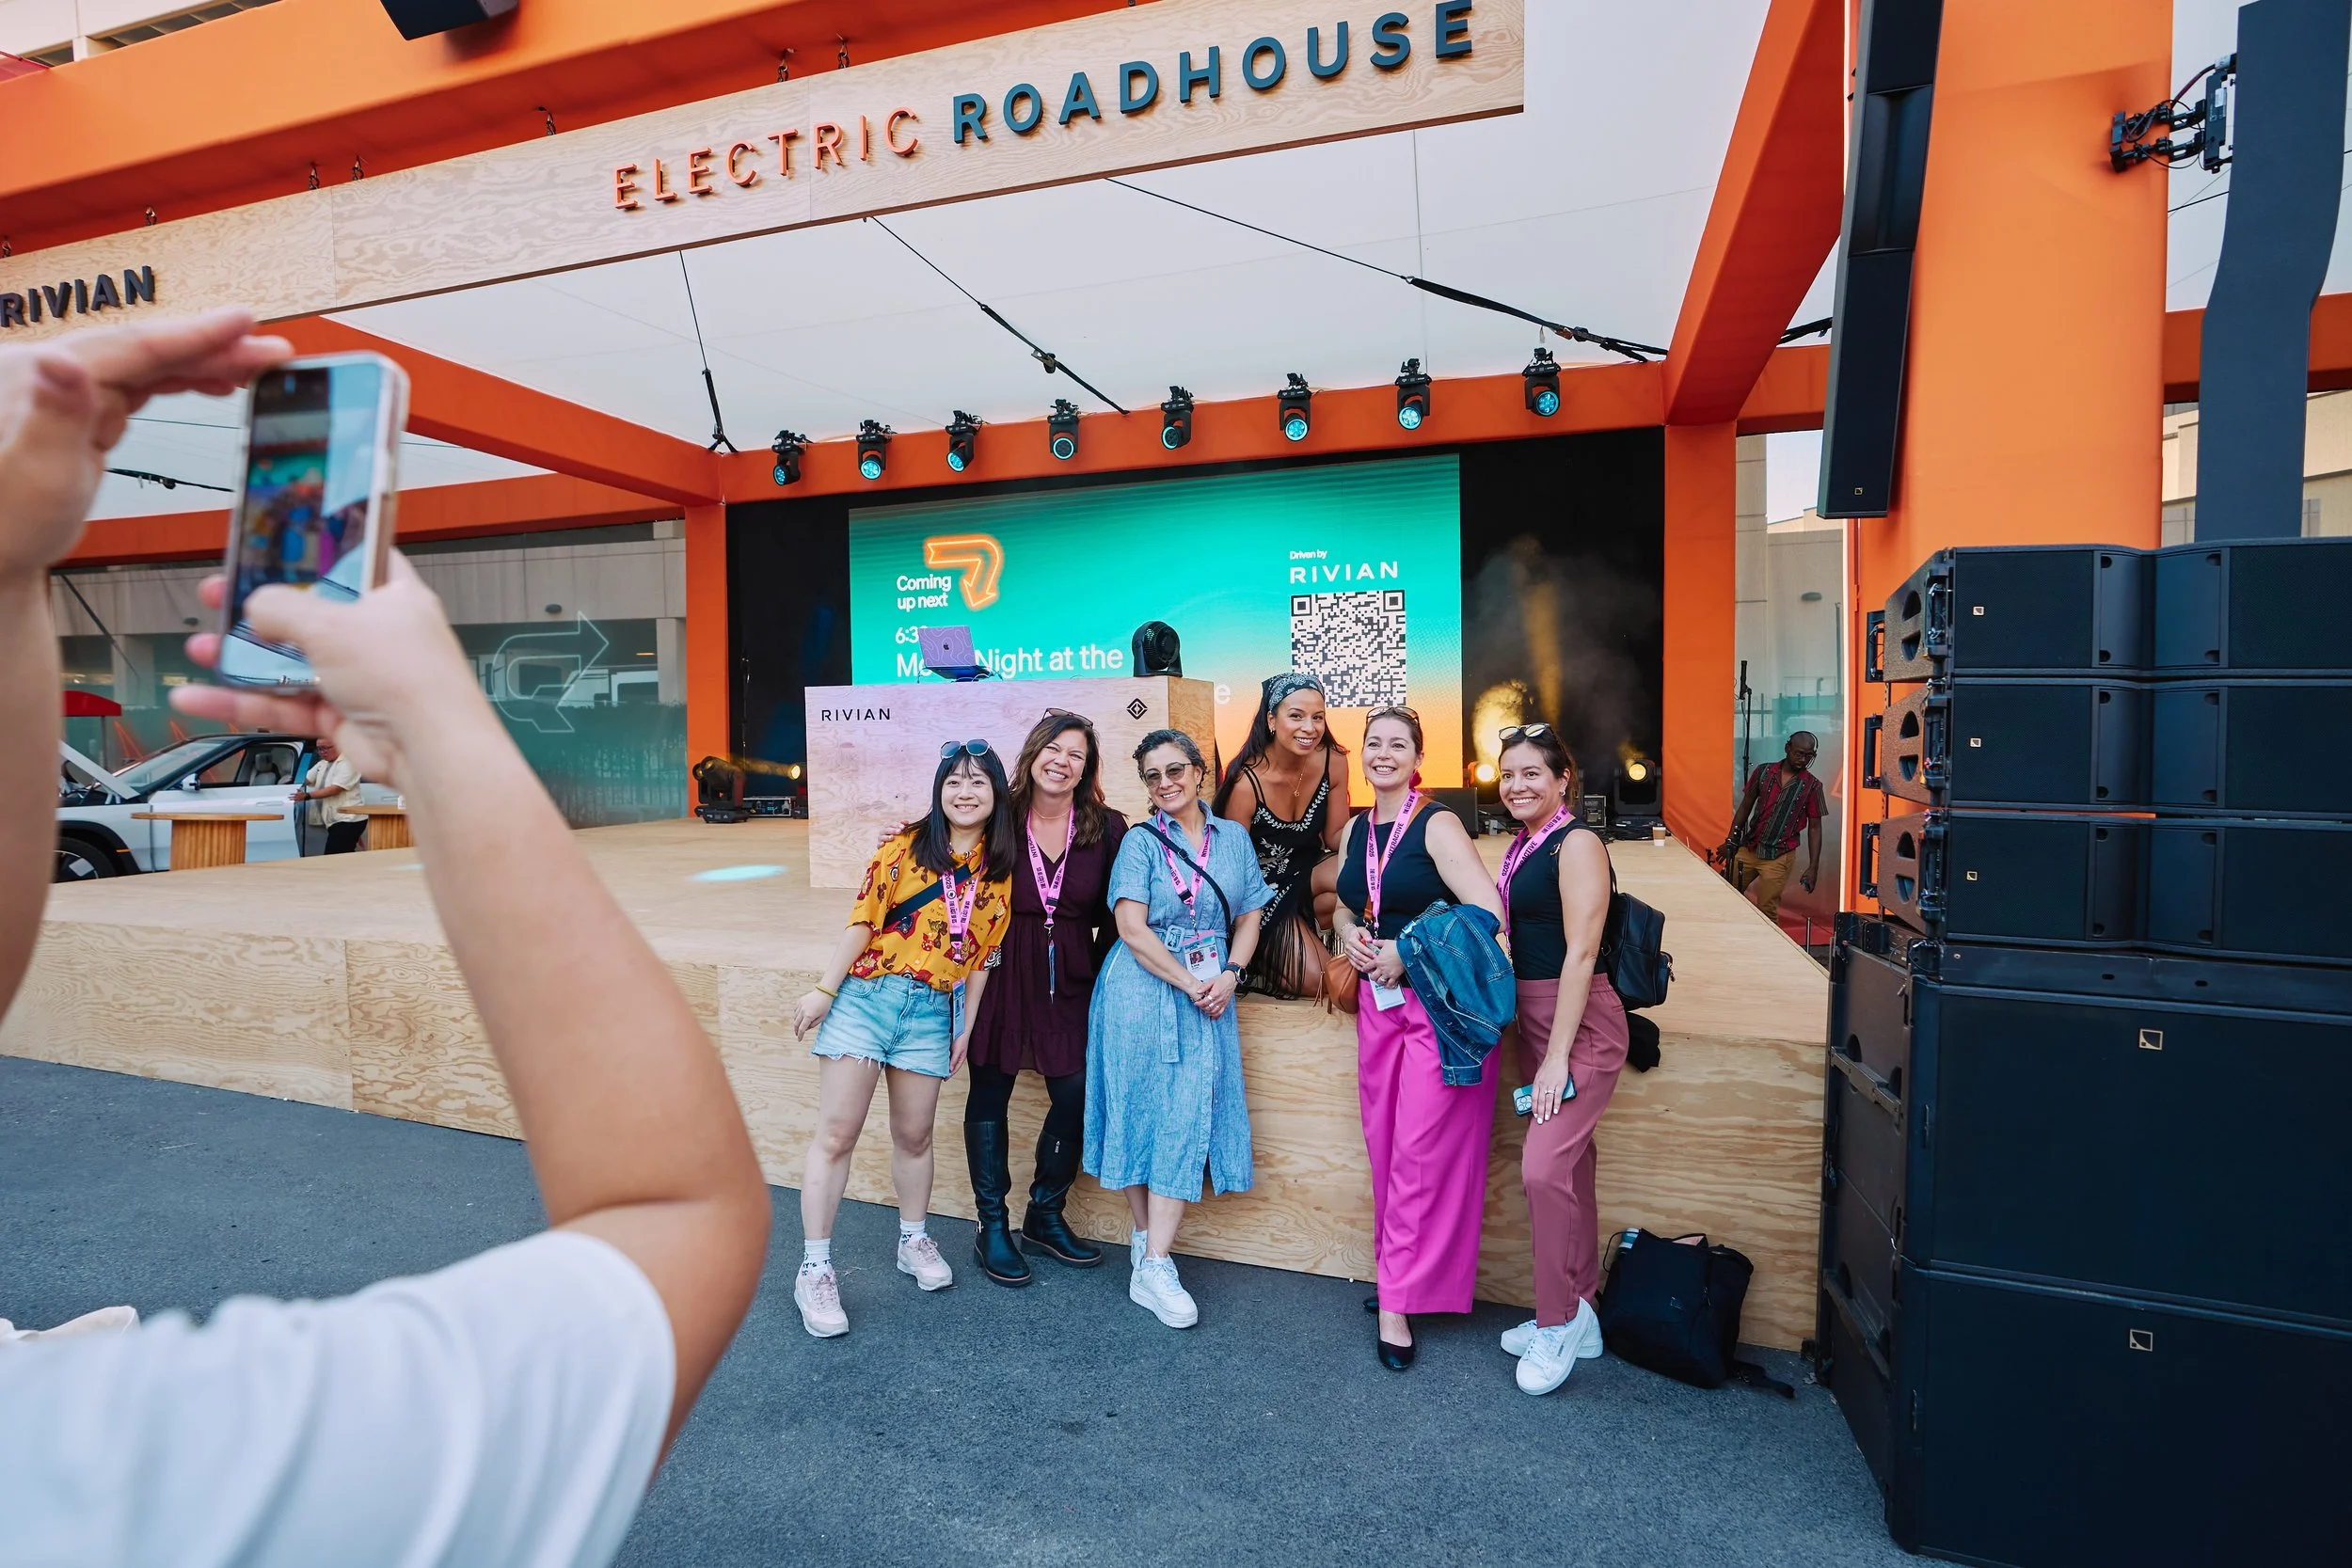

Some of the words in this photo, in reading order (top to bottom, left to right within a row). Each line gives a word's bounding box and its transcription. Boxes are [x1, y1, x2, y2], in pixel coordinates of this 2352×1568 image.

[614, 106, 919, 210] ELECTRIC
[953, 0, 1473, 144] ROADHOUSE
[0, 265, 155, 328] RIVIAN
[1289, 551, 1316, 560] Driven
[1317, 549, 1327, 559] by
[1290, 562, 1398, 584] RIVIAN
[897, 574, 952, 591] Coming
[898, 596, 915, 611] up
[918, 593, 948, 608] next
[895, 625, 929, 643] 6:3
[975, 647, 1043, 678] Night
[1049, 646, 1074, 671] at
[1079, 644, 1123, 670] the
[821, 708, 890, 721] RIVIAN
